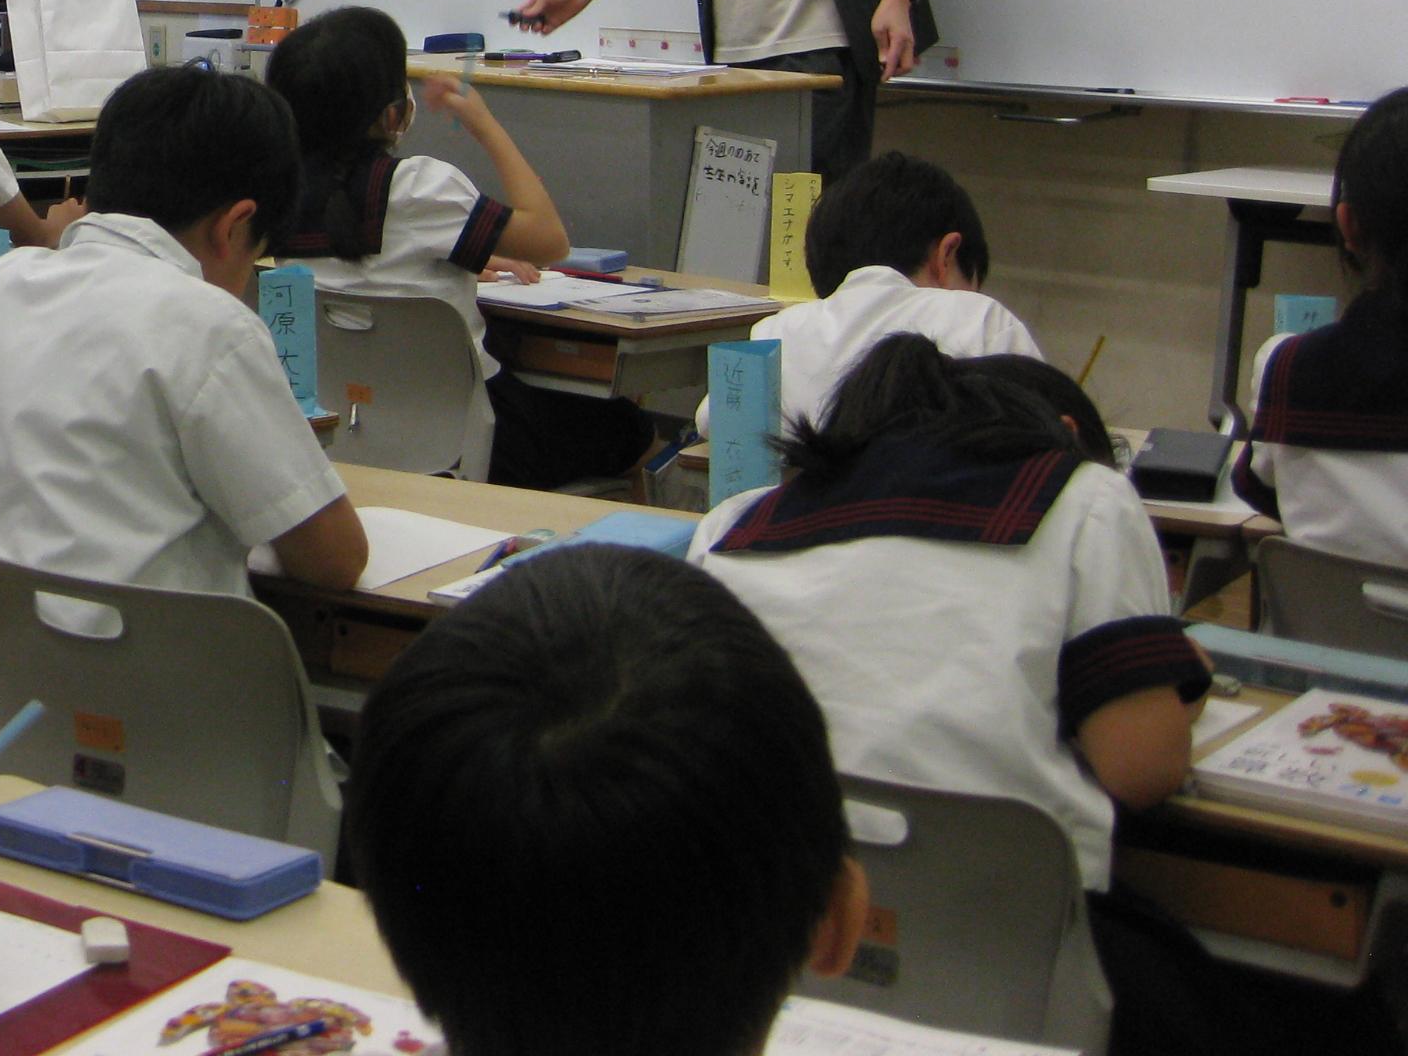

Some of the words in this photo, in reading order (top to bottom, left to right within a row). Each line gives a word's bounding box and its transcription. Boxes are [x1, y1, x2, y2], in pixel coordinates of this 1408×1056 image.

[705, 138, 761, 163] 今週のめあて
